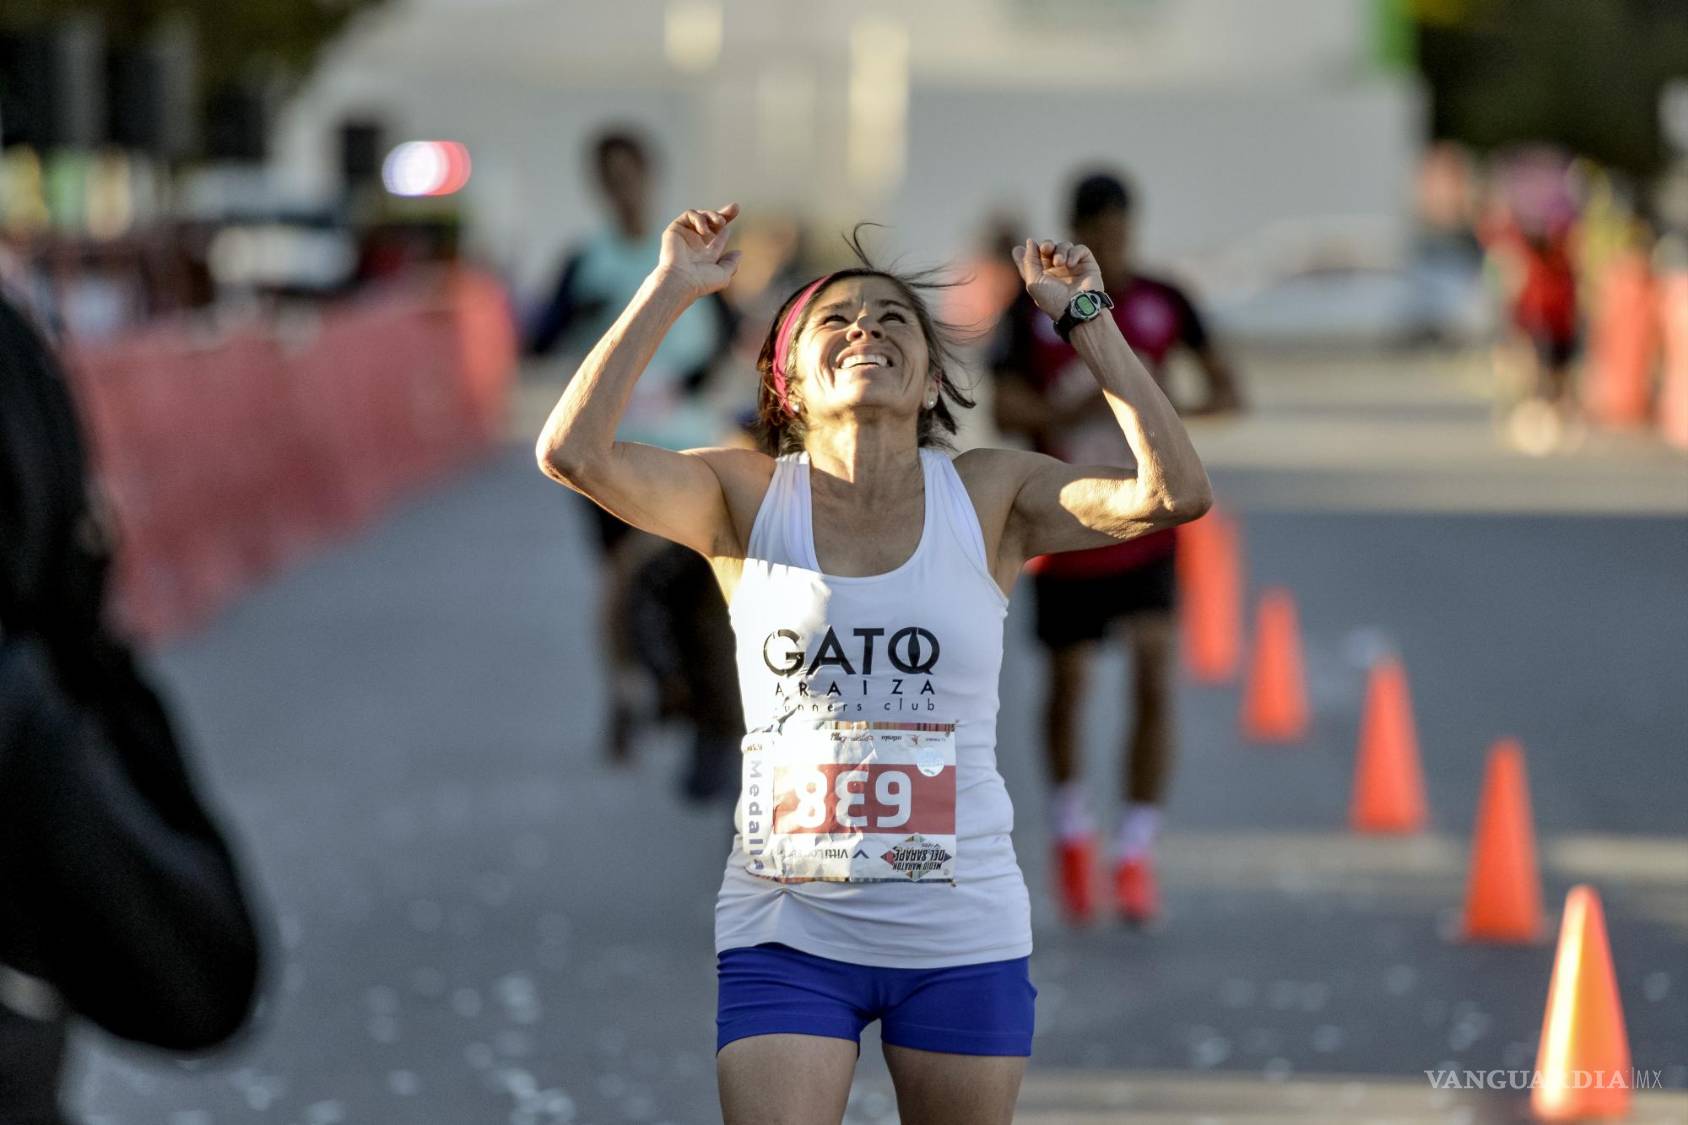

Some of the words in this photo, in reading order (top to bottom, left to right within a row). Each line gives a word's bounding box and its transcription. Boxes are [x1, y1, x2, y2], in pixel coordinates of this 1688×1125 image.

[763, 626, 940, 675] GATO
[775, 680, 936, 695] ARAIZA
[774, 702, 862, 712] unners
[884, 698, 935, 711] club
[793, 770, 912, 828] 638
[894, 849, 928, 862] SARAPE
[930, 849, 946, 862] DEL
[922, 862, 943, 871] MEDIO
